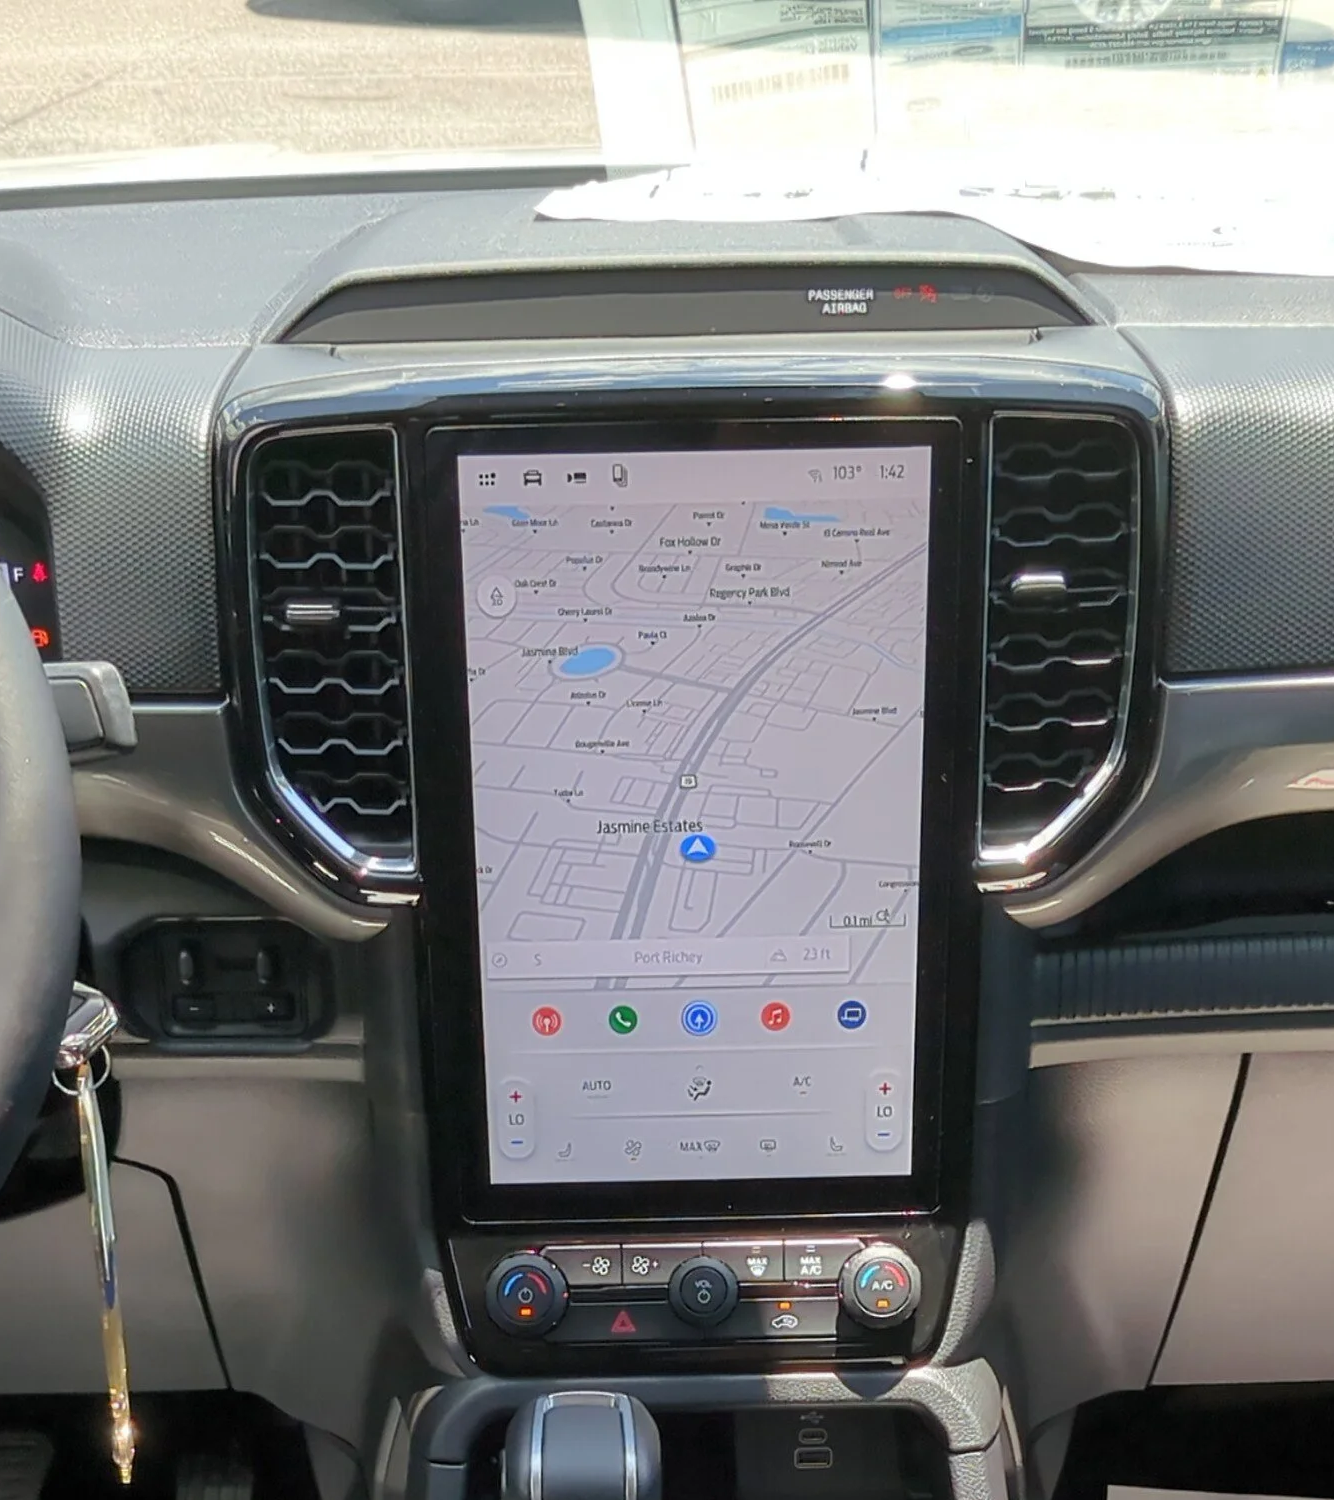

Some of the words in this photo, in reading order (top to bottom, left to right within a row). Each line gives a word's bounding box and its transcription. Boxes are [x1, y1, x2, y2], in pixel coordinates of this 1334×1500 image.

[807, 289, 874, 301] PASSENGER
[822, 302, 867, 315] AIRBAG
[833, 465, 862, 480] 103°
[880, 464, 905, 480] 1:42
[677, 536, 708, 547] Hollow
[13, 567, 23, 582] F
[709, 587, 747, 601] Regency
[748, 586, 768, 598] Park
[770, 586, 791, 598] Blvd
[596, 819, 650, 835] Jasmine
[652, 818, 704, 834] Estates
[634, 951, 660, 964] Port
[662, 950, 703, 966] Richey
[803, 947, 818, 961] 23
[820, 947, 831, 961] ft
[581, 1080, 612, 1093] AUTO
[792, 1075, 812, 1089] A/C
[876, 1105, 893, 1118] LO
[508, 1113, 525, 1126] LO
[679, 1141, 703, 1152] MAX
[747, 1257, 768, 1268] MAX
[799, 1256, 822, 1267] MAX
[799, 1265, 823, 1276] A/C
[871, 1280, 894, 1292] A/C
